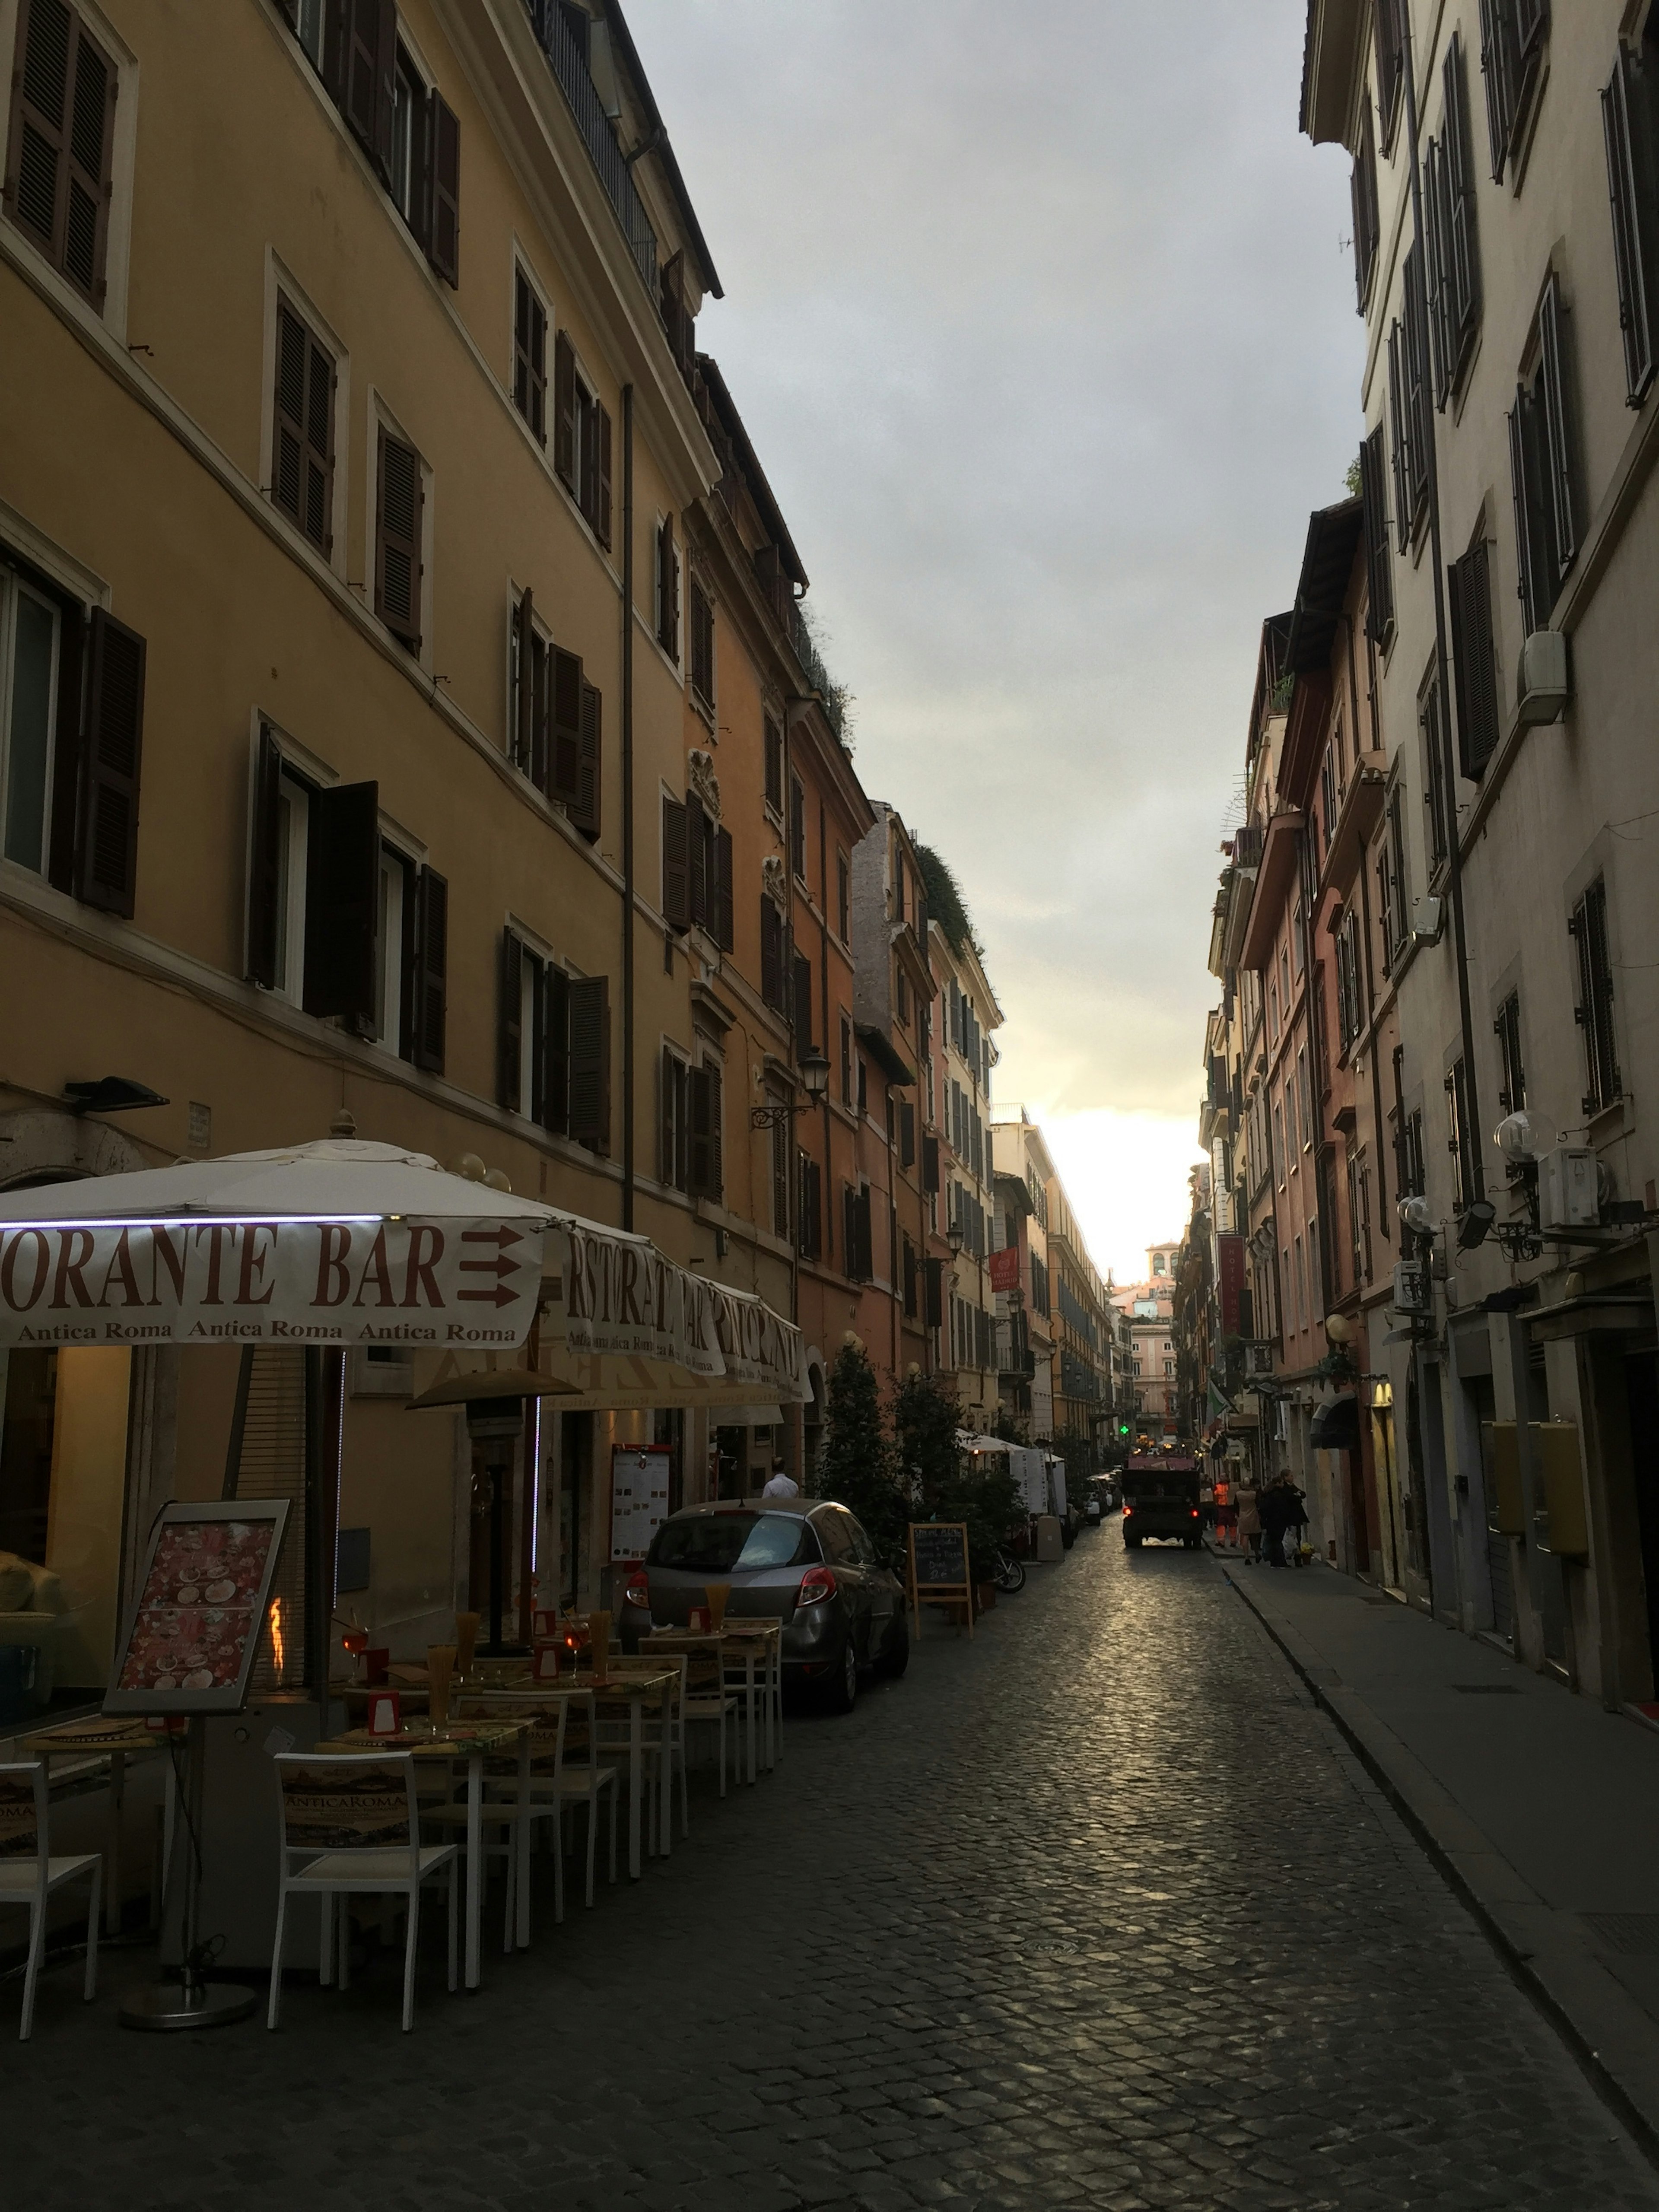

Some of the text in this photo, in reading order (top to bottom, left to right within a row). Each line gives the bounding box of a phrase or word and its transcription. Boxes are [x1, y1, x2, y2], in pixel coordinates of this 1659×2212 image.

[0, 1224, 446, 1312] ORANTE BAR
[993, 1277, 1017, 1286] MADRID
[18, 1320, 516, 1341] Antica Roma Antica Roma Antica Roma
